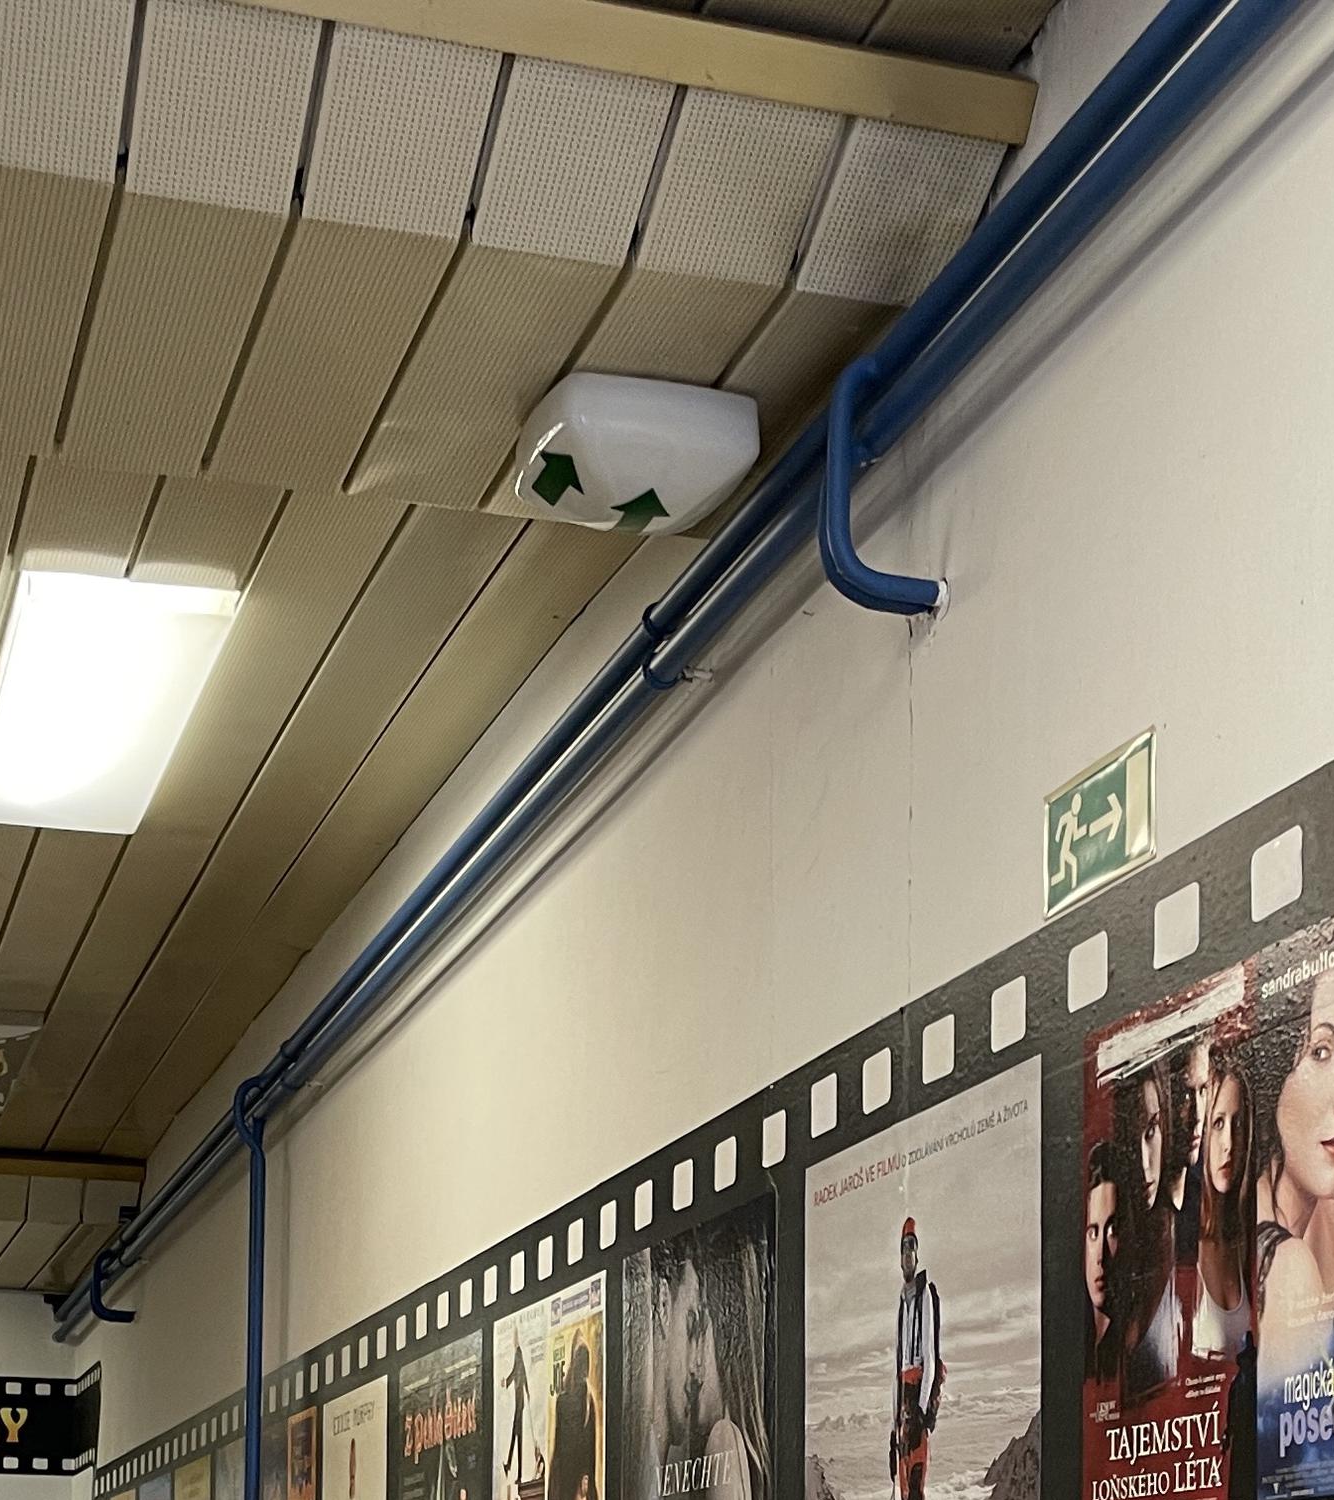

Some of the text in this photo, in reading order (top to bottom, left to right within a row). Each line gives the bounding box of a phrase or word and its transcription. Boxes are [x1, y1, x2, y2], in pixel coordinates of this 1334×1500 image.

[839, 1166, 864, 1195] JAROŠ
[1284, 1358, 1334, 1411] magická
[1106, 1400, 1221, 1466] TAJEMSTVÍ
[655, 1449, 734, 1498] NENECHTE
[1173, 1452, 1223, 1493] LÉTA
